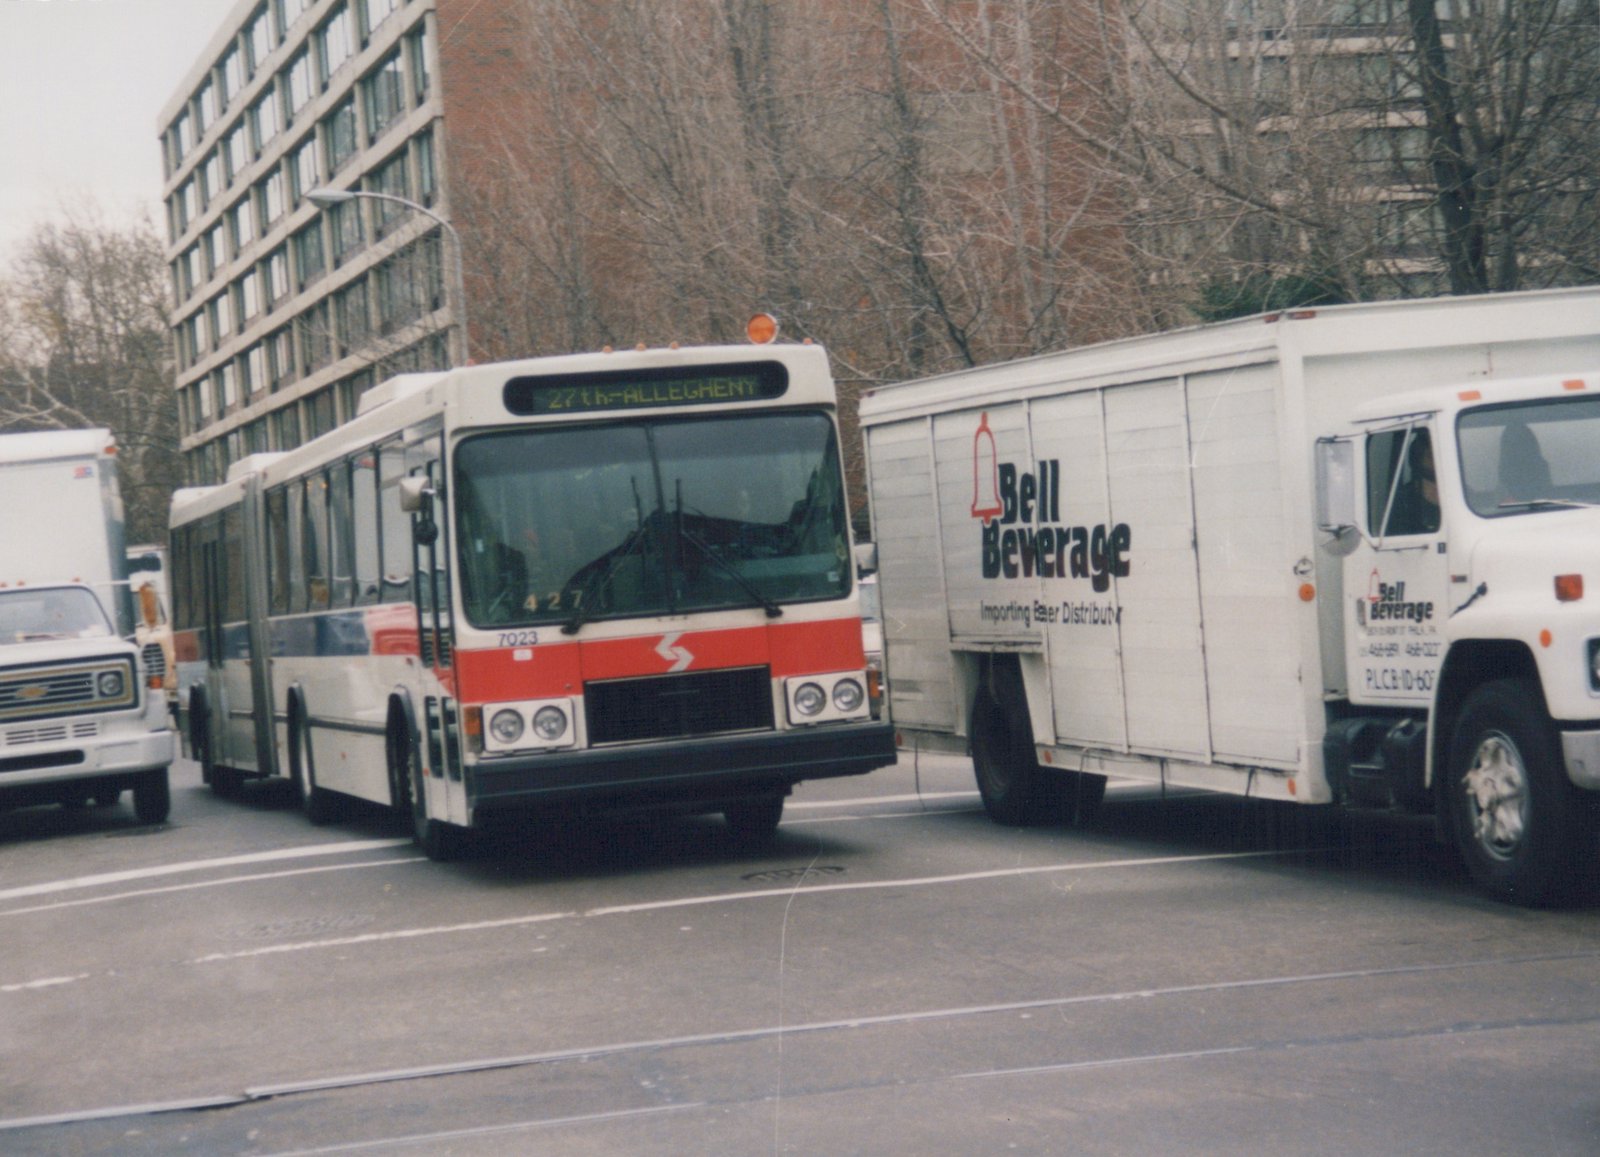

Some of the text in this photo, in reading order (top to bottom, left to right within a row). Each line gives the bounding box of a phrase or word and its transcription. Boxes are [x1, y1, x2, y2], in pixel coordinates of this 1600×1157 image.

[998, 459, 1060, 524] Bell
[981, 518, 1131, 593] Beverage
[1379, 581, 1405, 602] Bell
[981, 600, 1030, 628] Importing
[1062, 601, 1122, 625] Distributr
[1371, 602, 1433, 623] Beverage
[497, 630, 538, 648] 7023
